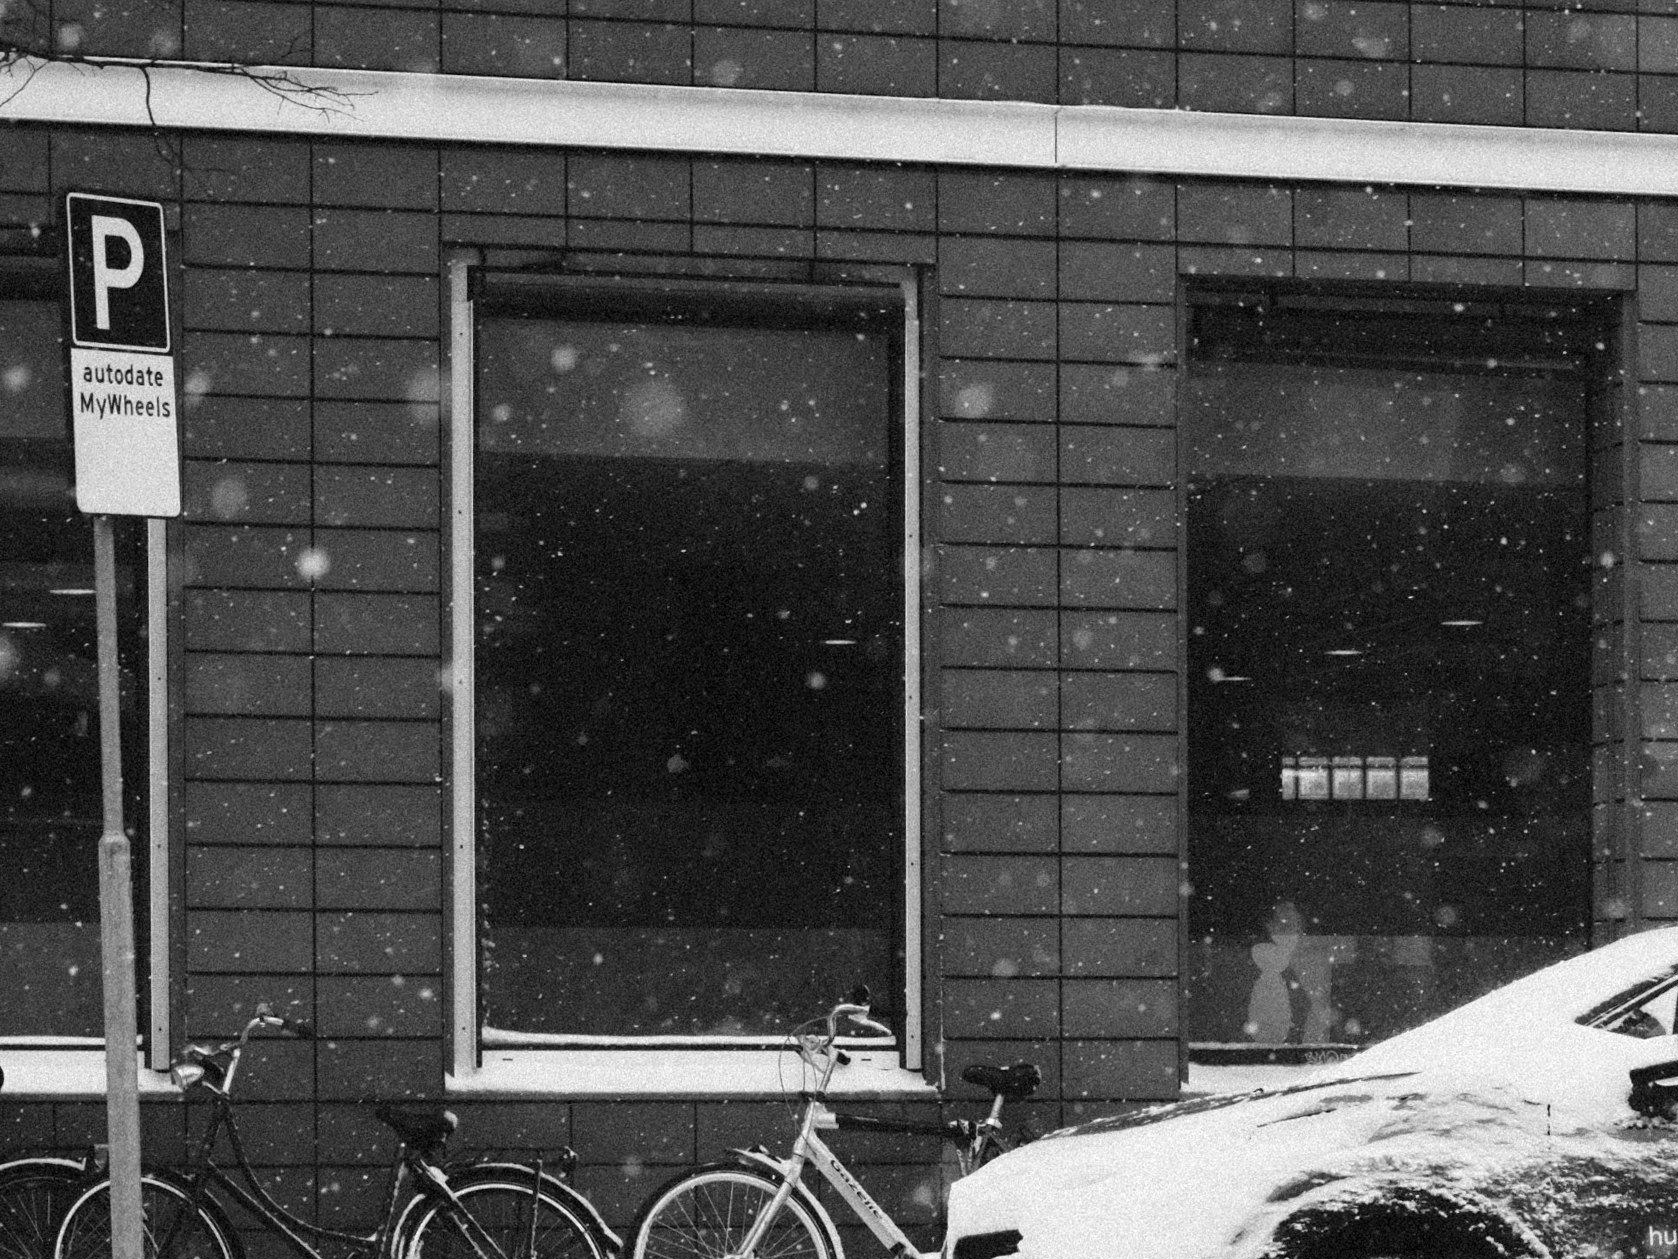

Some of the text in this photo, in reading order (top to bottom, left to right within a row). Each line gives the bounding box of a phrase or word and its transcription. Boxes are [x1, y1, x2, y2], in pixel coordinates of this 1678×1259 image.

[92, 215, 145, 330] P
[83, 364, 164, 387] autodate
[80, 392, 171, 420] MyWheels
